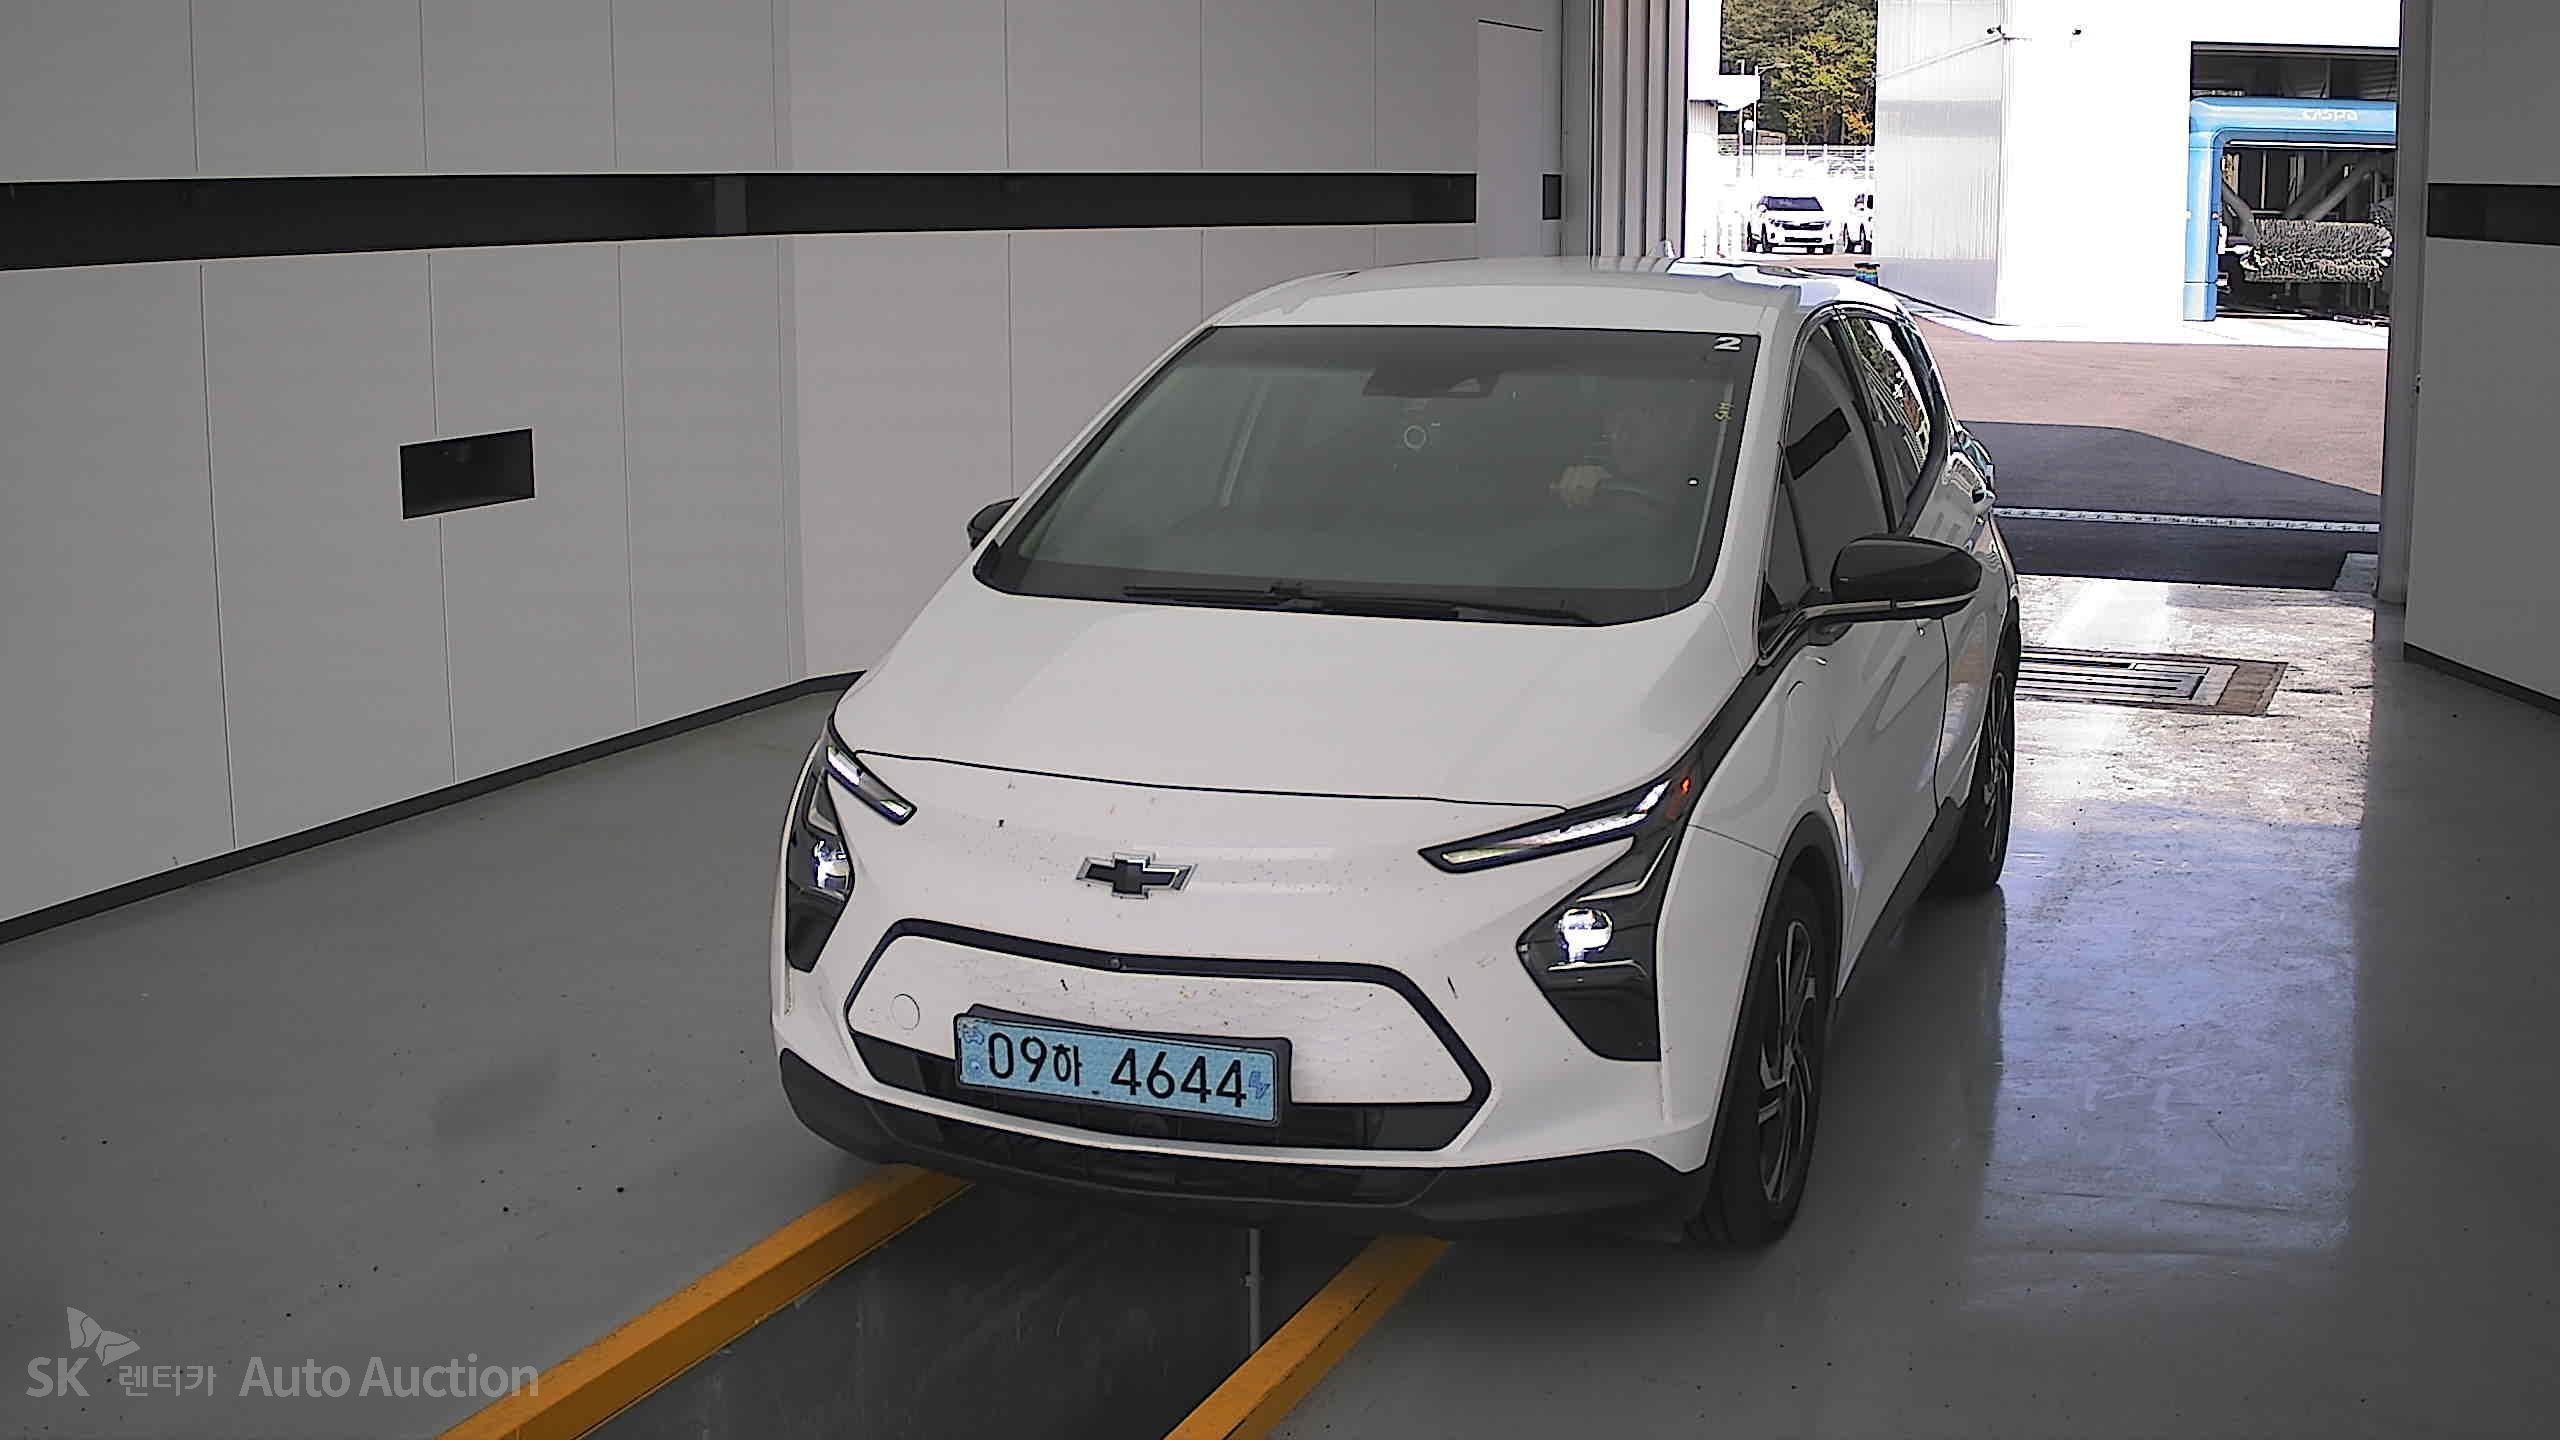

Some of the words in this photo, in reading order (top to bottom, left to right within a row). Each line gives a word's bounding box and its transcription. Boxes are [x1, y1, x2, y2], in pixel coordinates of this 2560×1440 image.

[1713, 336, 1742, 351] 2
[988, 1032, 1082, 1087] 09하
[1110, 1048, 1247, 1108] 4644
